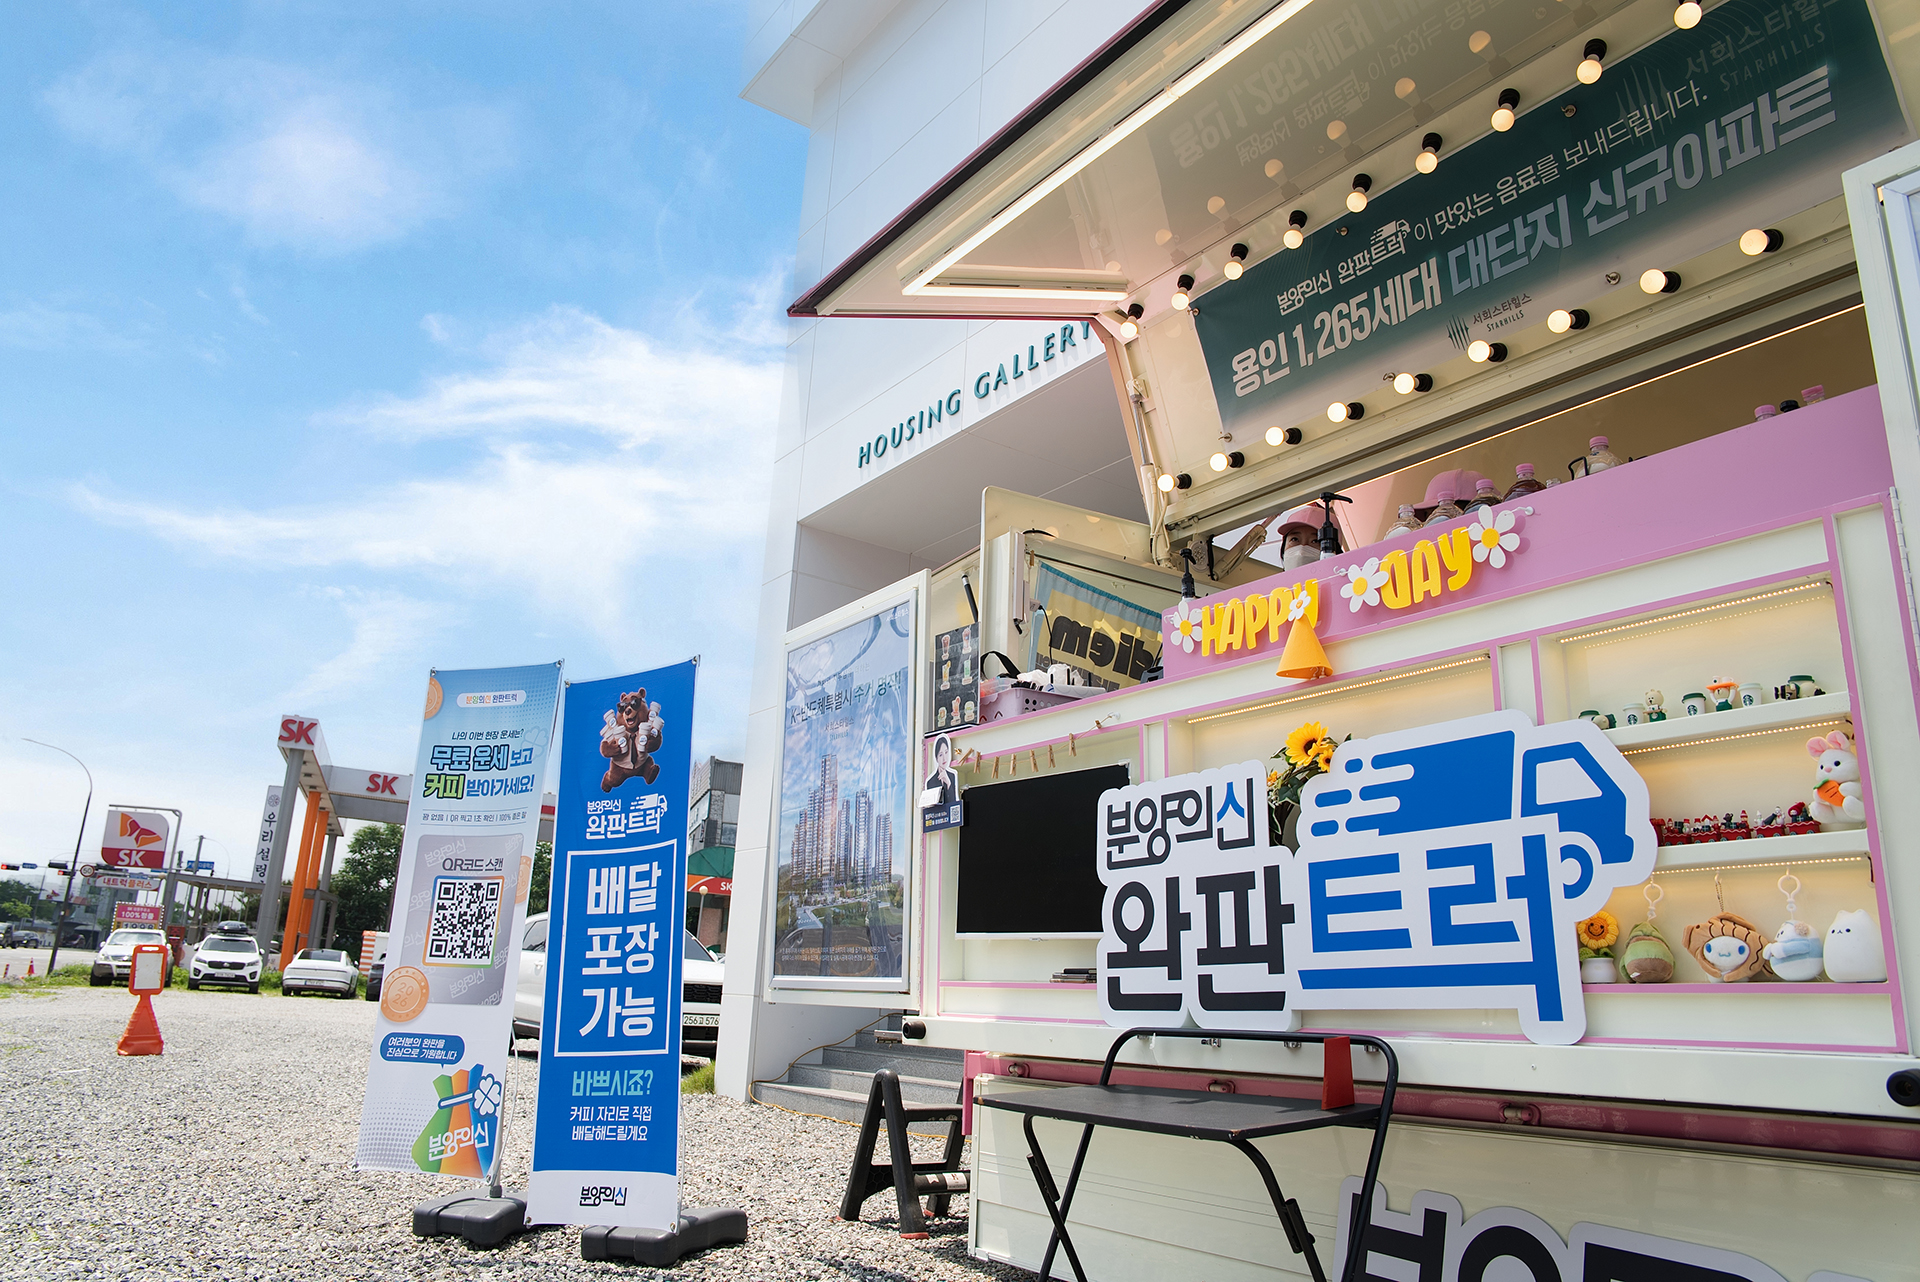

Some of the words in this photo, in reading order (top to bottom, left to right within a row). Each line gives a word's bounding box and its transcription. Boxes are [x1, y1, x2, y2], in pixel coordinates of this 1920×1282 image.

[1684, 0, 1837, 79] 서희스타힐
[1720, 23, 1826, 92] STARHILLS
[1276, 269, 1333, 316] 분양의신
[1338, 229, 1406, 285] 완판트럭
[1435, 193, 1494, 235] 맛있는
[1496, 153, 1560, 206] 음료를
[1563, 80, 1708, 170] 보내드립니다.
[1231, 331, 1291, 397] 용인
[1292, 257, 1442, 368] 1,265세대
[1447, 194, 1573, 297] 대단지
[1583, 64, 1837, 237] 신규아파트
[1473, 293, 1532, 325] 서희스타힐스
[1486, 309, 1525, 332] STARHILLS
[858, 388, 961, 469] HOUSING
[974, 321, 1090, 400] GALLERY
[1201, 578, 1319, 657] HAPPY
[1379, 526, 1474, 610] DAY
[466, 695, 491, 704] 분양의신
[492, 693, 518, 703] 완판트럭
[278, 718, 318, 746] SK
[452, 731, 467, 741] 나의
[468, 731, 483, 741] 이번
[485, 730, 499, 740] 현장
[500, 728, 524, 740] 운세는?
[430, 744, 472, 771] 무료
[472, 744, 510, 771] 운세
[510, 747, 534, 767] 보고
[366, 773, 399, 796] SK
[423, 773, 466, 800] 커피
[466, 774, 535, 797] 받아가세요!
[450, 814, 459, 822] QR
[499, 813, 511, 822] 100%
[587, 799, 621, 814] 분양의신
[586, 807, 661, 840] 완판트럭
[1106, 777, 1255, 871] 분양의신
[116, 849, 146, 867] SK
[255, 811, 277, 884] 우리설렁
[83, 867, 92, 875] 50
[442, 858, 484, 871] QR코드
[484, 857, 504, 871] 스캔
[103, 877, 152, 889] 내트럭플러스
[586, 861, 662, 914] 배달
[720, 881, 733, 891] SK
[1106, 834, 1565, 1022] 완판트럭
[582, 922, 660, 975] 포장
[397, 982, 414, 996] 20
[579, 987, 656, 1038] 가능
[705, 1016, 719, 1026] 576
[386, 1047, 419, 1058] 진심으로
[420, 1048, 457, 1060] 기원합니다
[388, 1037, 421, 1048] 여러분의
[422, 1038, 446, 1049] 완판을
[572, 1069, 654, 1097] 바쁘시죠?
[569, 1106, 594, 1122] 커피
[596, 1106, 630, 1122] 자리로
[631, 1105, 653, 1122] 직접
[428, 1121, 489, 1162] 분양의신
[571, 1125, 648, 1141] 배달해드릴게요
[579, 1186, 628, 1207] 분양의신
